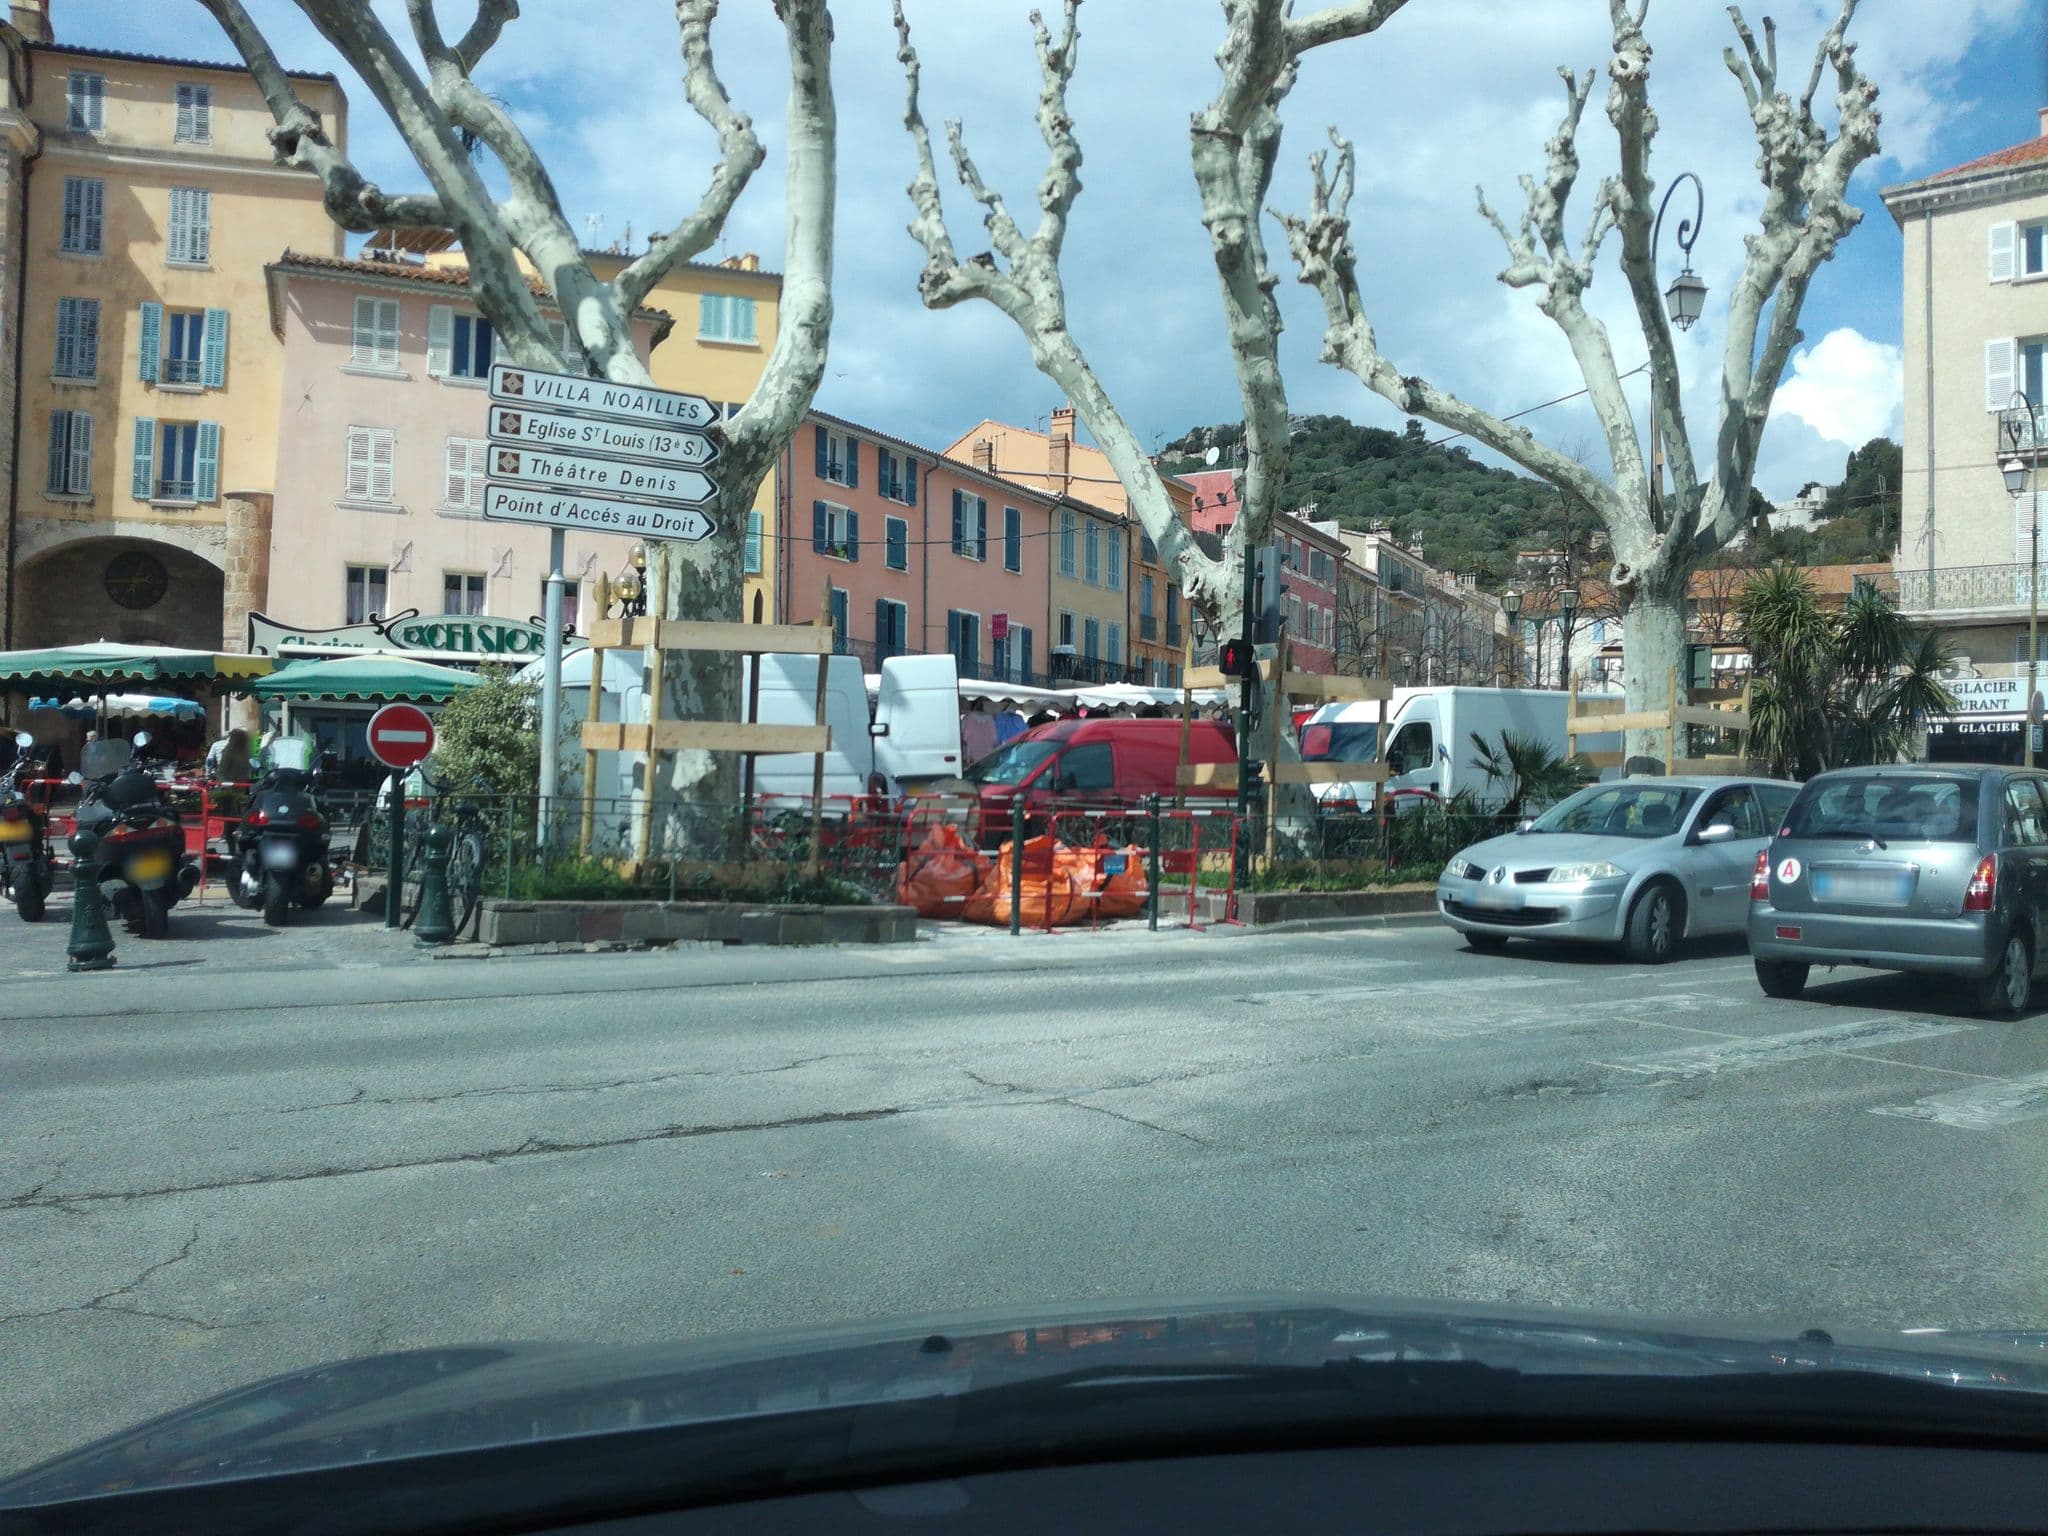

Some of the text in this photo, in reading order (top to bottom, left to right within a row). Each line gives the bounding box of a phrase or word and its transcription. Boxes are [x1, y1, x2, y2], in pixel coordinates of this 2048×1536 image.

[534, 380, 701, 419] VILLA NOAILLES
[527, 419, 577, 440] Eglise
[602, 430, 645, 450] Louis
[683, 440, 703, 458] S.)
[531, 458, 677, 491] Théâtre Denis
[495, 494, 543, 515] Point
[626, 517, 646, 527] au
[651, 513, 695, 533] Droit
[1953, 681, 2017, 694] GLACIER
[1959, 722, 2020, 733] GLACIER
[1783, 861, 1794, 878] A
